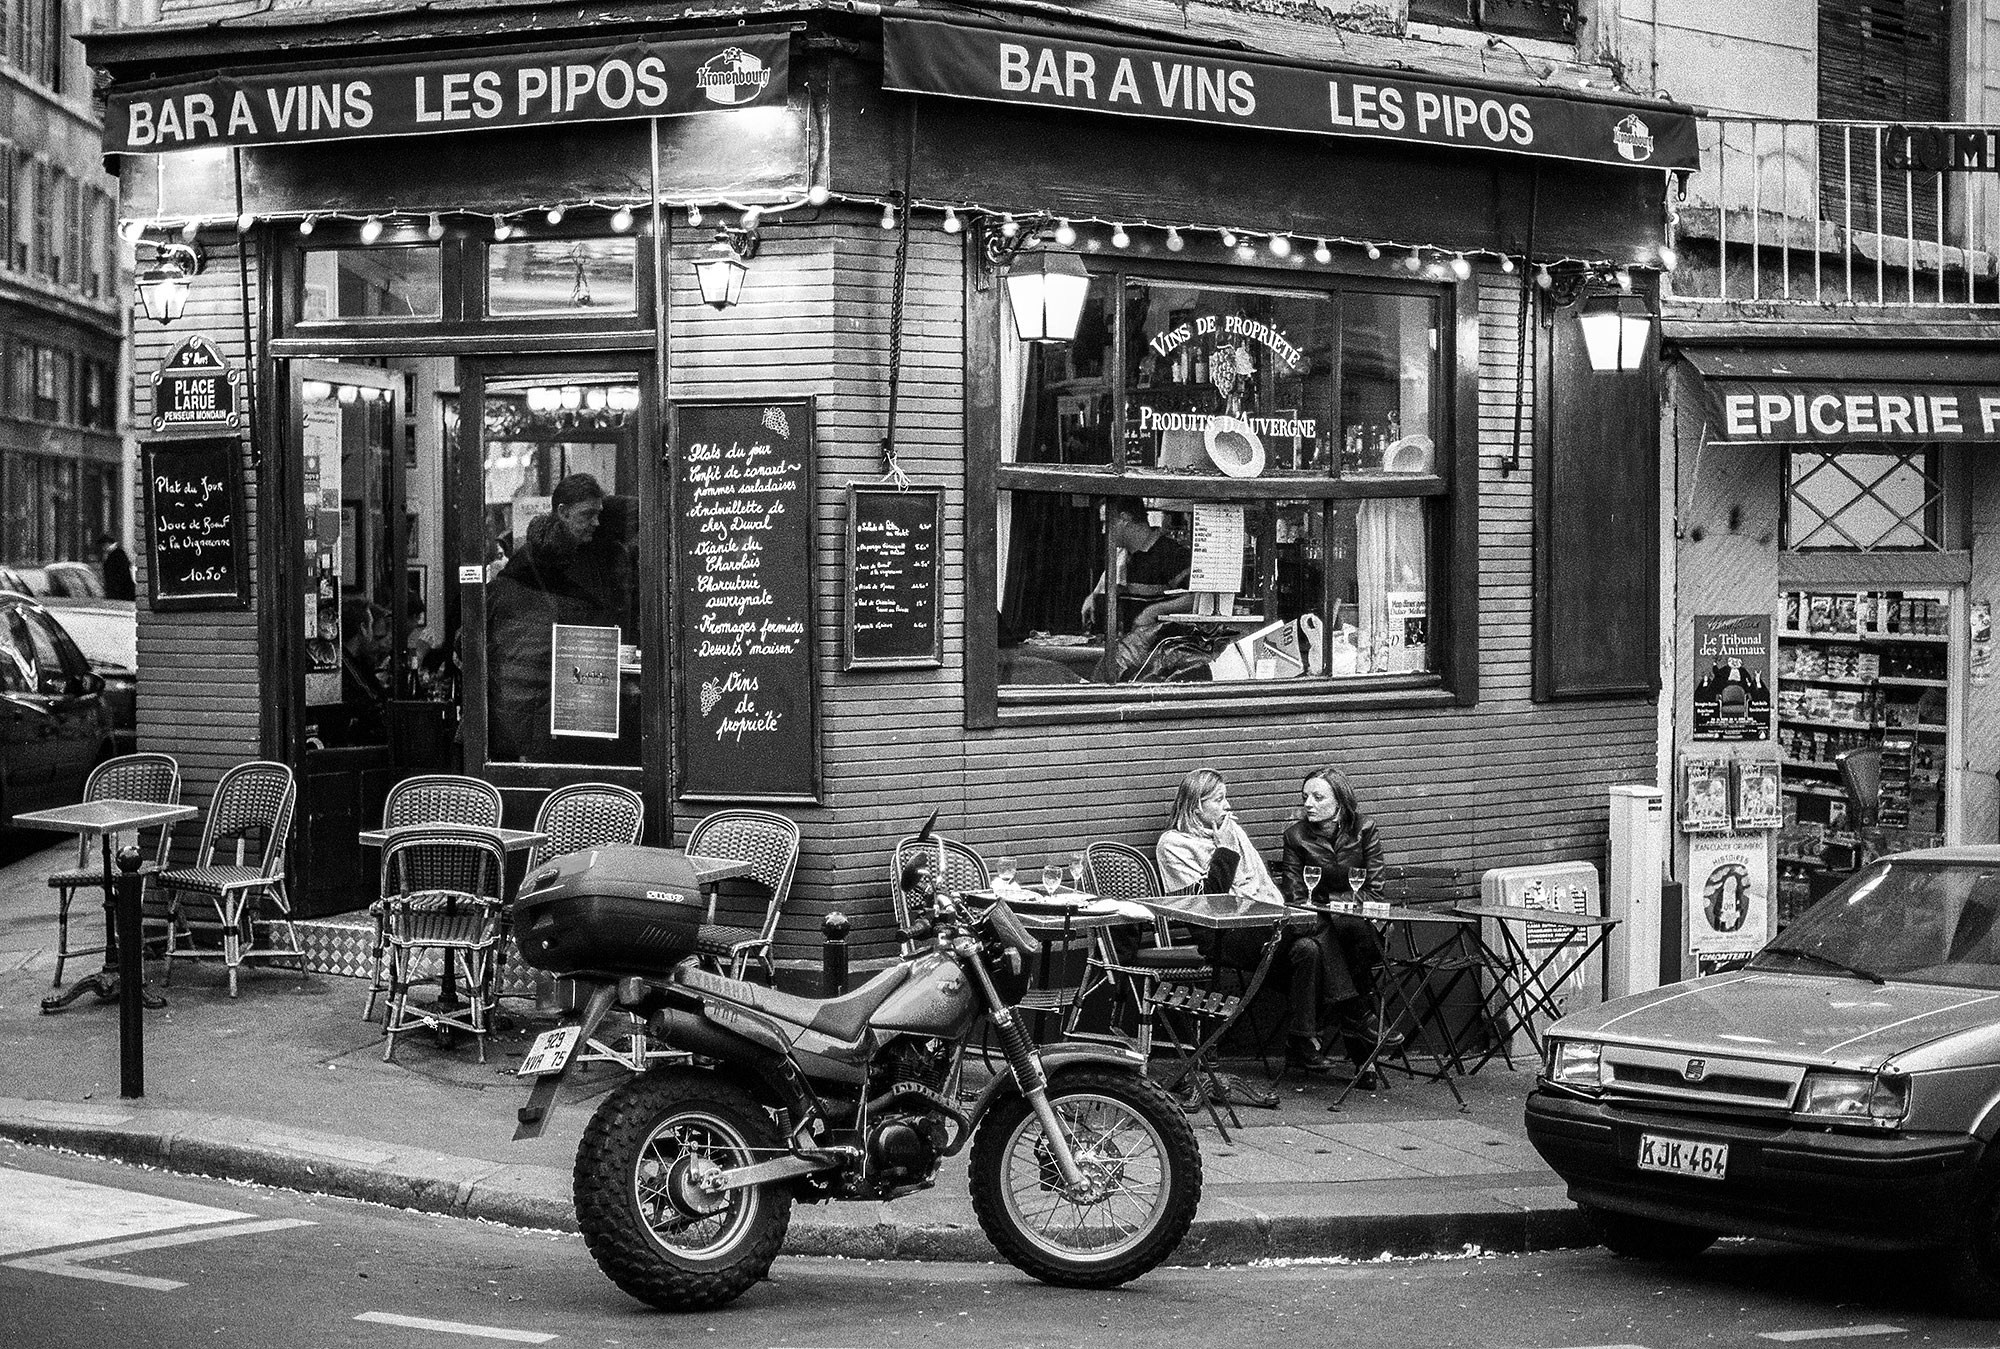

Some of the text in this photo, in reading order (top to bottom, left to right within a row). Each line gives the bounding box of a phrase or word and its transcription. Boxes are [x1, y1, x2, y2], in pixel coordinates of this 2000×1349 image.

[696, 67, 771, 88] Kronenbourg
[1000, 43, 1256, 116] BAR A VINS
[415, 57, 668, 124] LES PIPOS
[127, 80, 373, 147] BAR A VINS
[1329, 80, 1534, 146] LES PIPOS
[1150, 323, 1191, 357] VINS
[1196, 315, 1216, 335] DE
[175, 379, 215, 395] PLACE
[175, 395, 215, 410] LARUE
[1140, 406, 1216, 431] PRODUITS
[1726, 394, 1963, 435] EPICERIE
[688, 441, 772, 466] Plats du jour
[690, 460, 786, 487] Confit de canard
[155, 475, 181, 494] Plat
[184, 481, 198, 494] du
[694, 484, 735, 502] pommes
[768, 500, 785, 514] de
[158, 515, 186, 532] Joue
[189, 519, 200, 530] de
[700, 515, 773, 541] chez Duval
[169, 535, 181, 549] la
[741, 536, 763, 551] du
[706, 553, 760, 572] Charolais
[698, 573, 760, 592] Charcuterie
[705, 589, 773, 616] auvergnate
[700, 612, 756, 642] Fromages
[1703, 633, 1762, 645] Le Tribunal
[1699, 645, 1766, 656] des Animaux
[722, 669, 759, 692] Vins
[735, 694, 755, 714] de
[551, 1051, 567, 1067] 75
